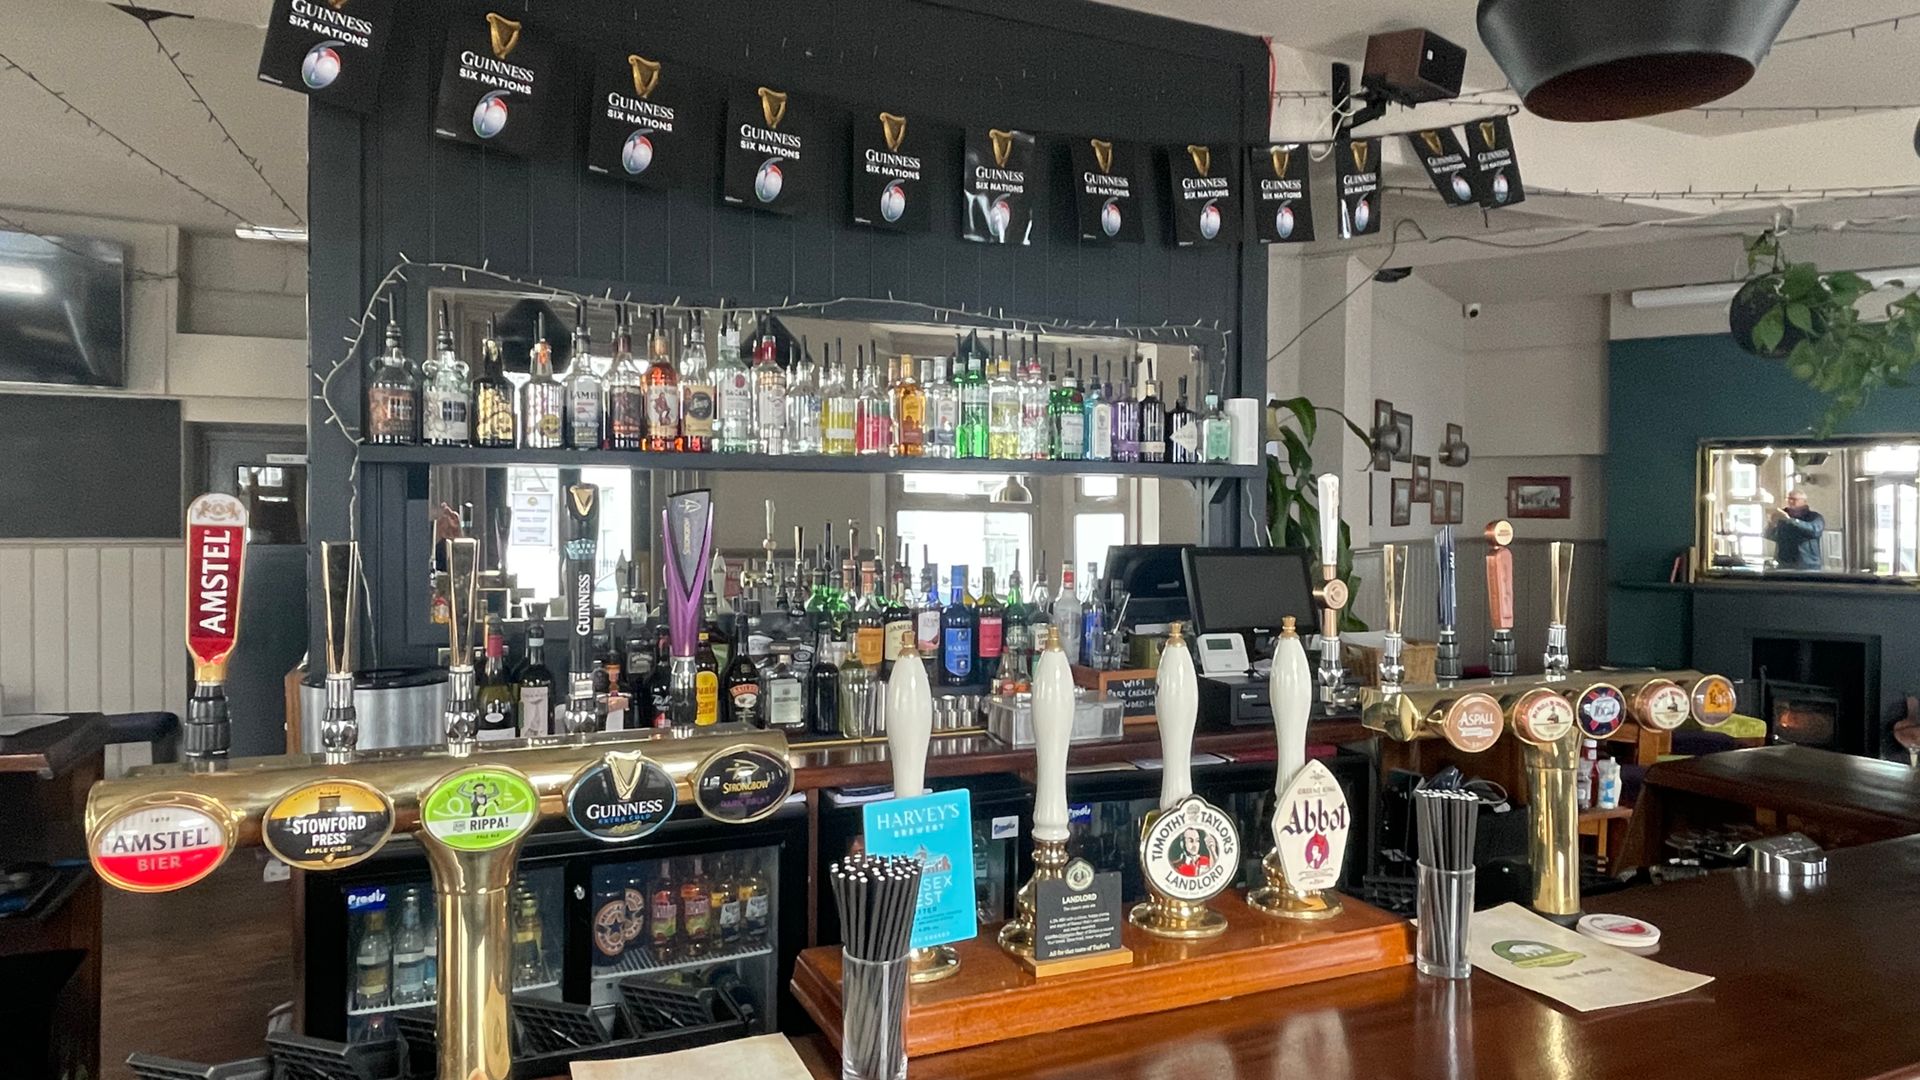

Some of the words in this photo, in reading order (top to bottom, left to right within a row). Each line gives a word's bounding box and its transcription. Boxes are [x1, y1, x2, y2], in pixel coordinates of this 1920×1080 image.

[291, 0, 372, 35] GUINNESS
[289, 15, 309, 29] SIX
[312, 21, 369, 48] NATIONS
[461, 51, 534, 82] GUINNESS
[459, 68, 478, 80] SIX
[480, 73, 532, 94] NATIONS
[608, 92, 674, 120] GUINNESS
[607, 109, 624, 120] SIX
[627, 114, 673, 132] NATIONS
[741, 124, 801, 148] GUINNESS
[740, 140, 756, 150] SIX
[758, 143, 800, 160] NATIONS
[866, 149, 920, 169] GUINNESS
[866, 164, 880, 175] SIX
[882, 167, 920, 180] NATIONS
[976, 166, 1024, 182] GUINNESS
[1084, 172, 1129, 188] GUINNESS
[975, 181, 988, 190] SIX
[990, 183, 1024, 194] NATIONS
[1086, 185, 1097, 194] SIX
[1099, 187, 1130, 198] NATIONS
[1182, 177, 1228, 189] GUINNESS
[1261, 179, 1302, 191] GUINNESS
[1184, 190, 1195, 199] SIX
[1197, 189, 1229, 199] NATIONS
[199, 530, 231, 635] AMSTEL
[576, 573, 591, 636] GUINNESS
[889, 624, 912, 633] JAMES
[1122, 679, 1145, 688] WIFI
[1459, 711, 1495, 727] ASPALL
[722, 780, 769, 794] STRONGBOW
[586, 799, 663, 820] GUINNESS
[877, 802, 960, 830] HARVEY'S
[1280, 799, 1347, 835] Abbot
[292, 815, 367, 835] STOWFORD
[470, 817, 509, 831] RIPPA!
[598, 816, 626, 825] EXTRA
[629, 813, 652, 821] COLD
[894, 823, 944, 838] BREWERY
[1152, 812, 1186, 861] TIMOTHY
[1201, 811, 1234, 855] TAYLOR'S
[112, 827, 209, 853] AMSTEL
[312, 832, 347, 847] PRESS
[329, 845, 352, 853] CIDER
[137, 855, 182, 872] BIER
[923, 875, 953, 892] SEX
[1165, 864, 1224, 891] LANDLORD
[916, 890, 943, 908] EST
[1062, 893, 1098, 905] LANDLORD
[917, 906, 937, 915] TTER
